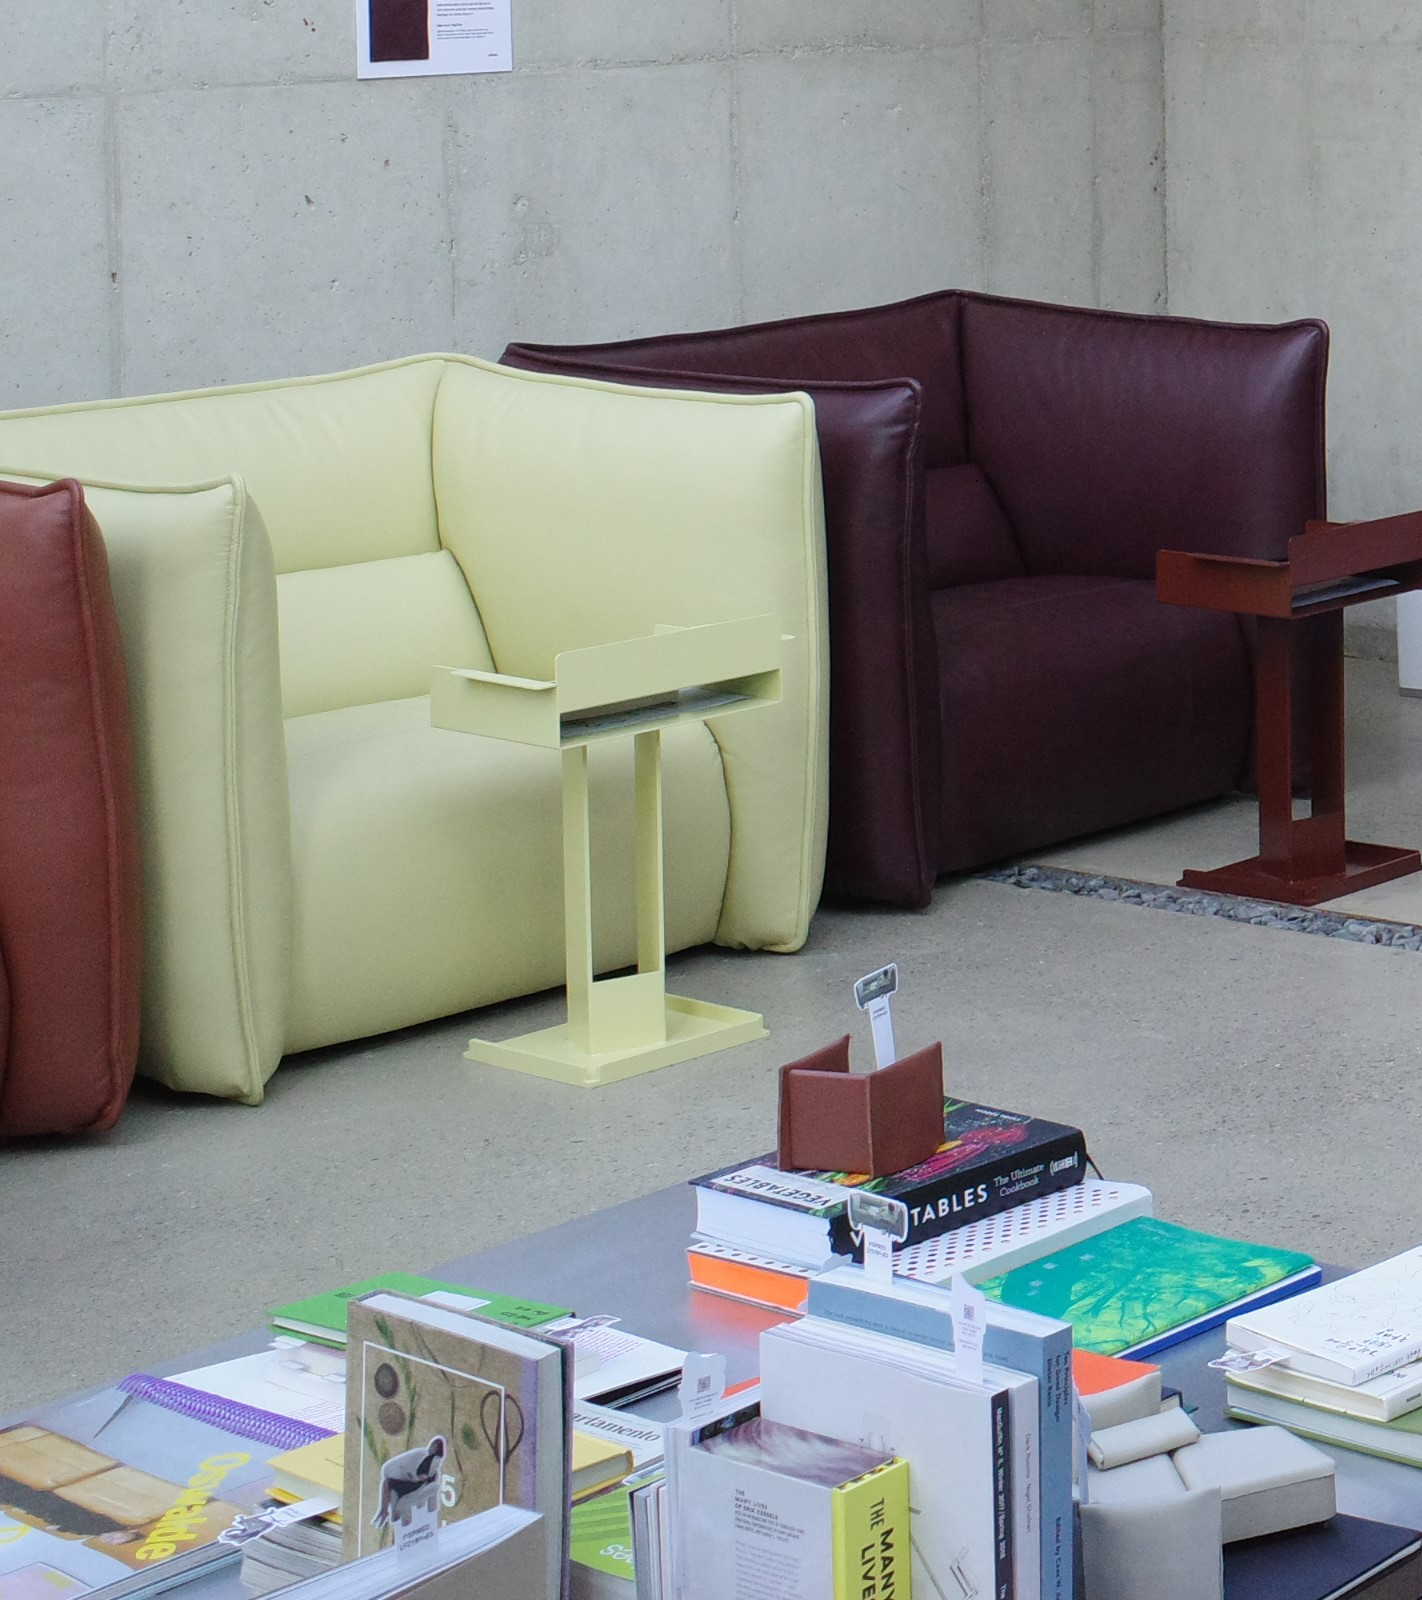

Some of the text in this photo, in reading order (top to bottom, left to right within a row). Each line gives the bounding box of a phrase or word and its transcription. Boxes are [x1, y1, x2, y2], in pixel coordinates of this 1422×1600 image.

[723, 1173, 831, 1208] VEGETABLES
[993, 1175, 1009, 1187] The
[1011, 1163, 1045, 1181] Ultimate
[999, 1177, 1039, 1197] Cookbook
[850, 1184, 989, 1248] VTABLES
[1062, 1367, 1070, 1406] Principles
[735, 1496, 768, 1510] MANY LIVES
[743, 1505, 755, 1513] ERIK
[757, 1509, 778, 1520] KESSELS
[870, 1497, 884, 1530] THE
[861, 1543, 875, 1600] LIVE
